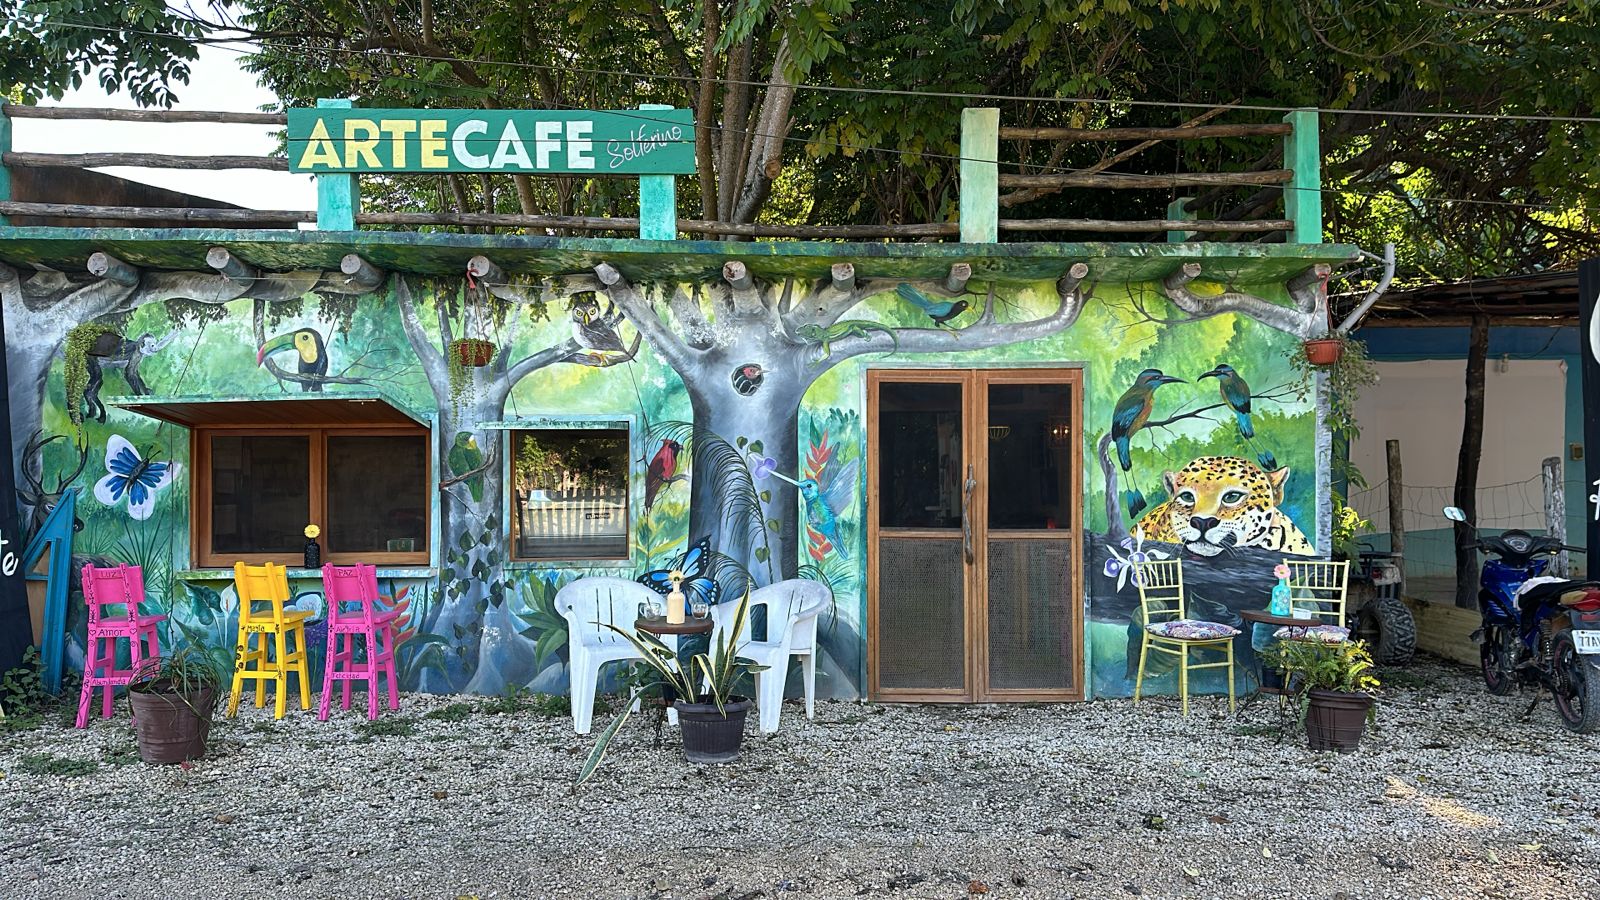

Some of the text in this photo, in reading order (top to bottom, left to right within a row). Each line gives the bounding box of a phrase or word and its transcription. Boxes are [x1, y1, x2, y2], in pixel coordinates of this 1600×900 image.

[298, 118, 682, 169] ARTECAFE Solferino
[337, 568, 353, 577] PAZ
[98, 628, 125, 637] Amor
